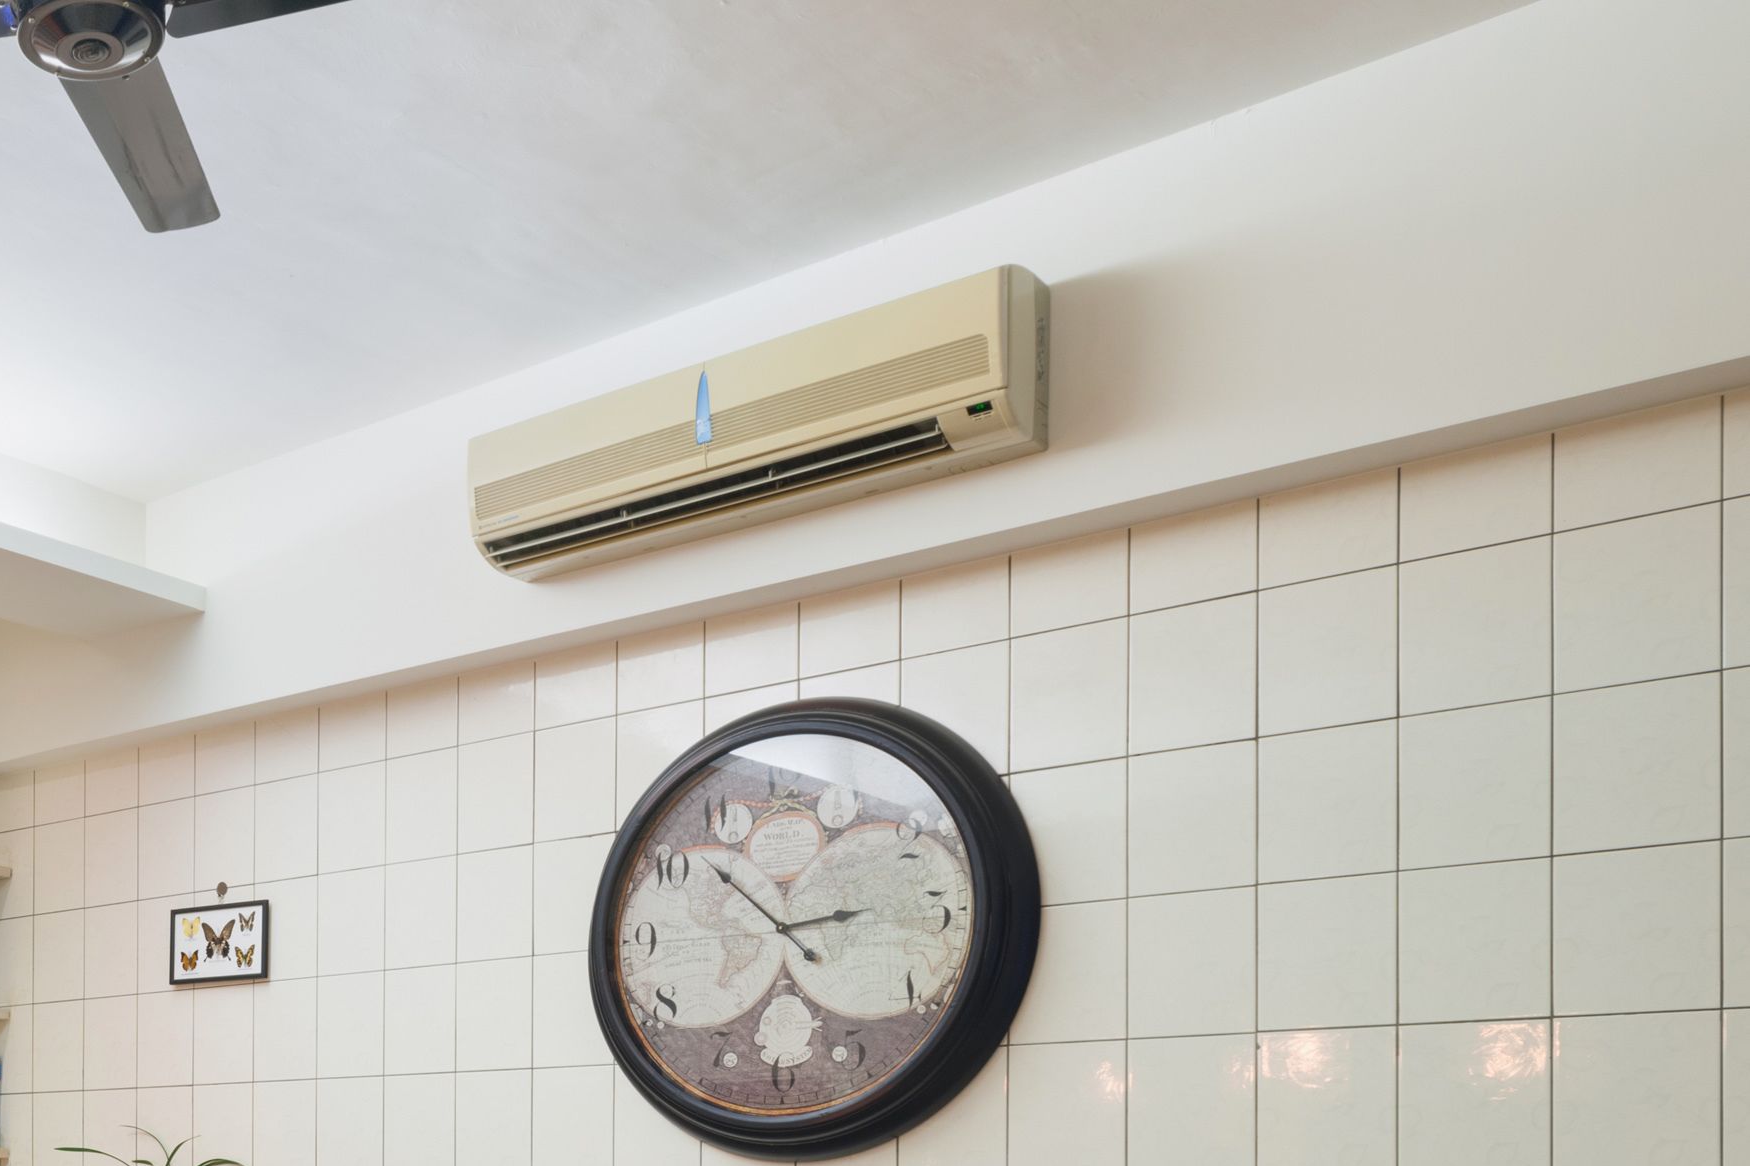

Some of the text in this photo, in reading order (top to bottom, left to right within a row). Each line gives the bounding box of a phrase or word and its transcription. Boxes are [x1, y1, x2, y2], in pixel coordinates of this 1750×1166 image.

[656, 852, 690, 890] 10
[925, 890, 952, 933] 3
[635, 921, 657, 958] 9
[653, 983, 677, 1019] 8
[890, 970, 922, 1008] 4
[710, 1031, 733, 1067] 7
[843, 1030, 867, 1070] 5
[770, 1055, 796, 1093] 6
